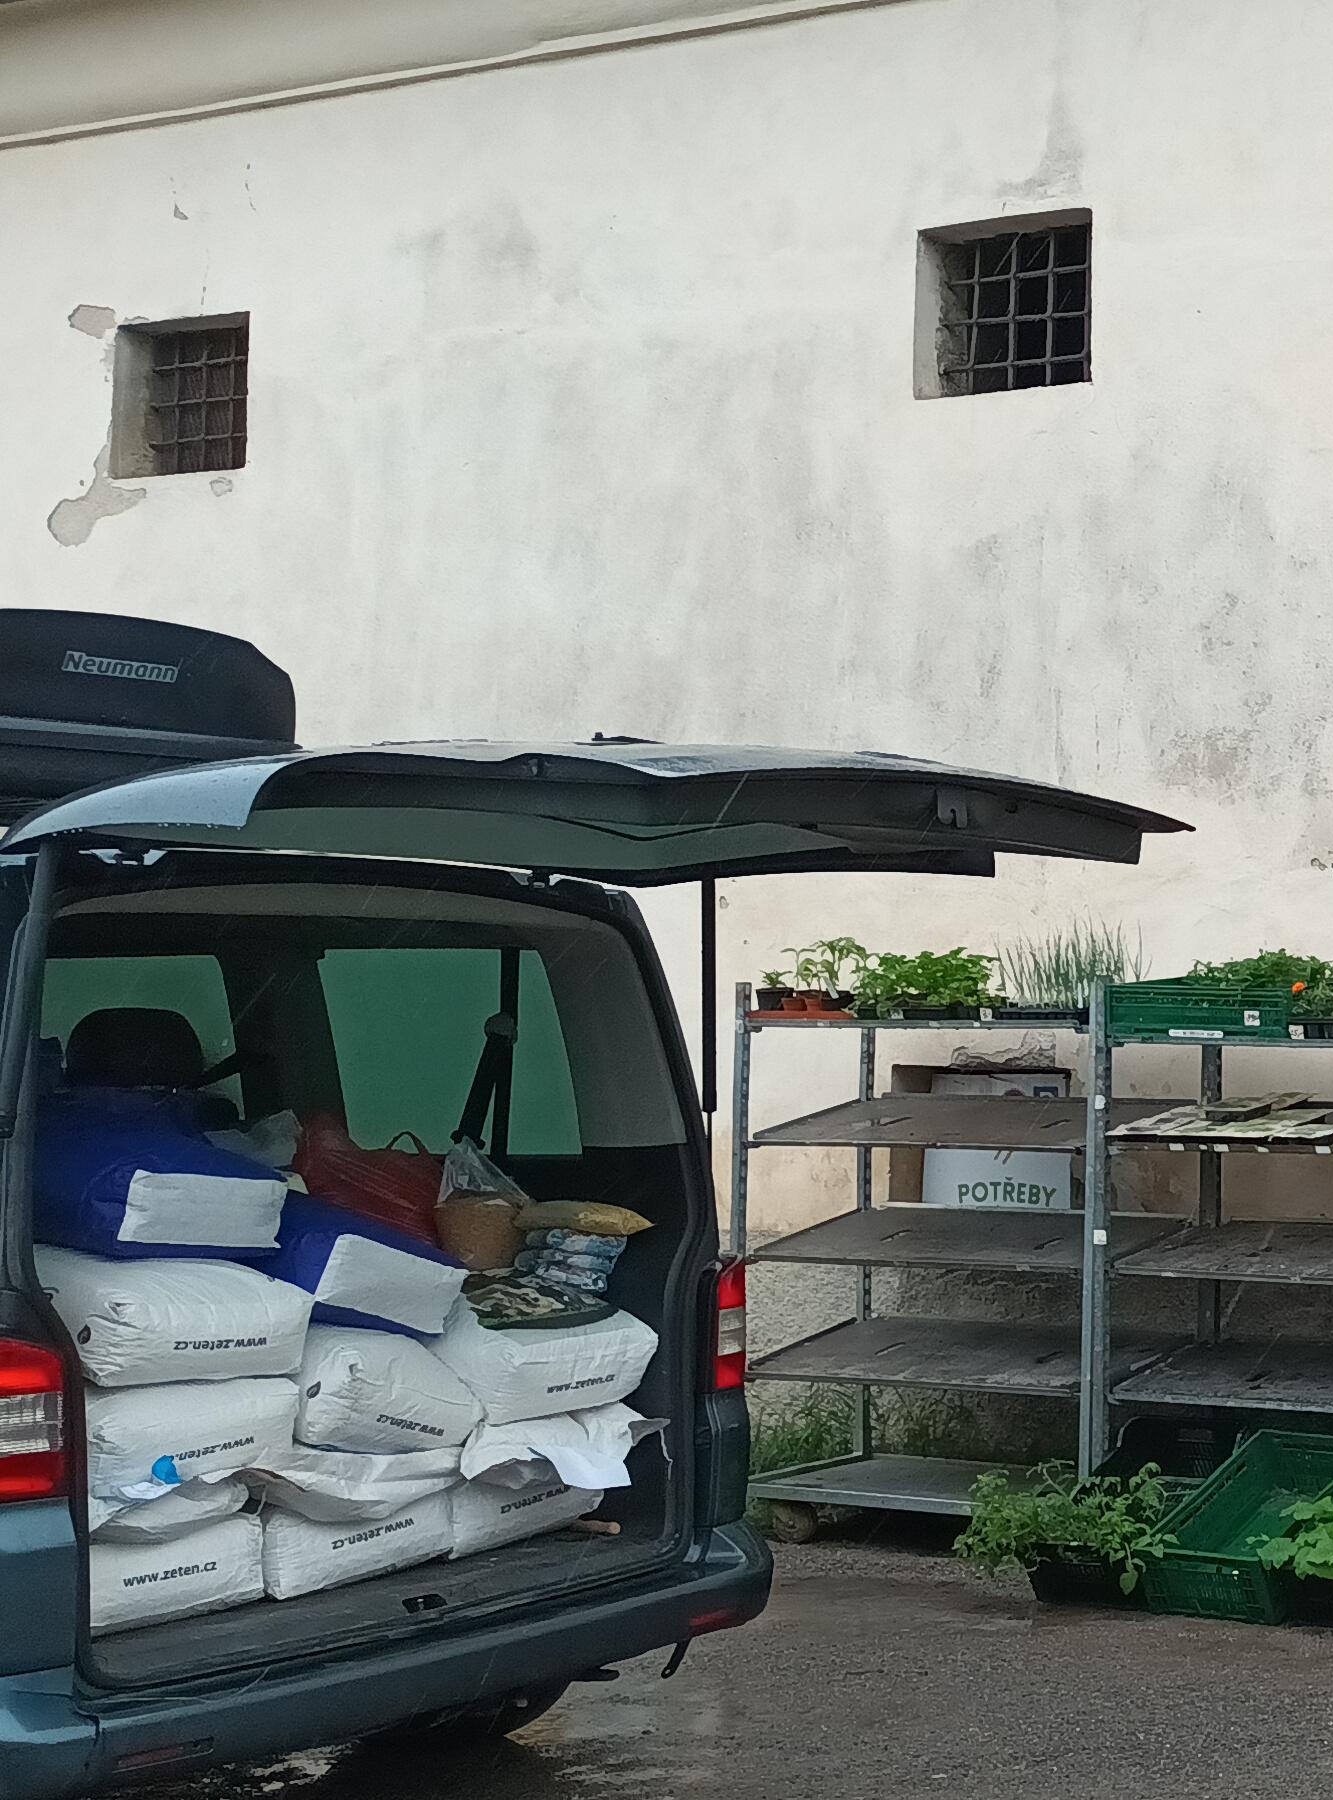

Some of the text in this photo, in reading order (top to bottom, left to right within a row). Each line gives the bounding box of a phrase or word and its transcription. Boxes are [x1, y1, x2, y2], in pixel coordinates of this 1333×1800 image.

[63, 652, 178, 681] Neumann
[957, 1176, 1057, 1207] POTŘEBY
[173, 1337, 268, 1351] www.zeten.cz
[174, 1436, 255, 1461] www.zeten.
[331, 1517, 415, 1550] www.zeten.cz
[122, 1561, 218, 1588] www.zeten.cz
